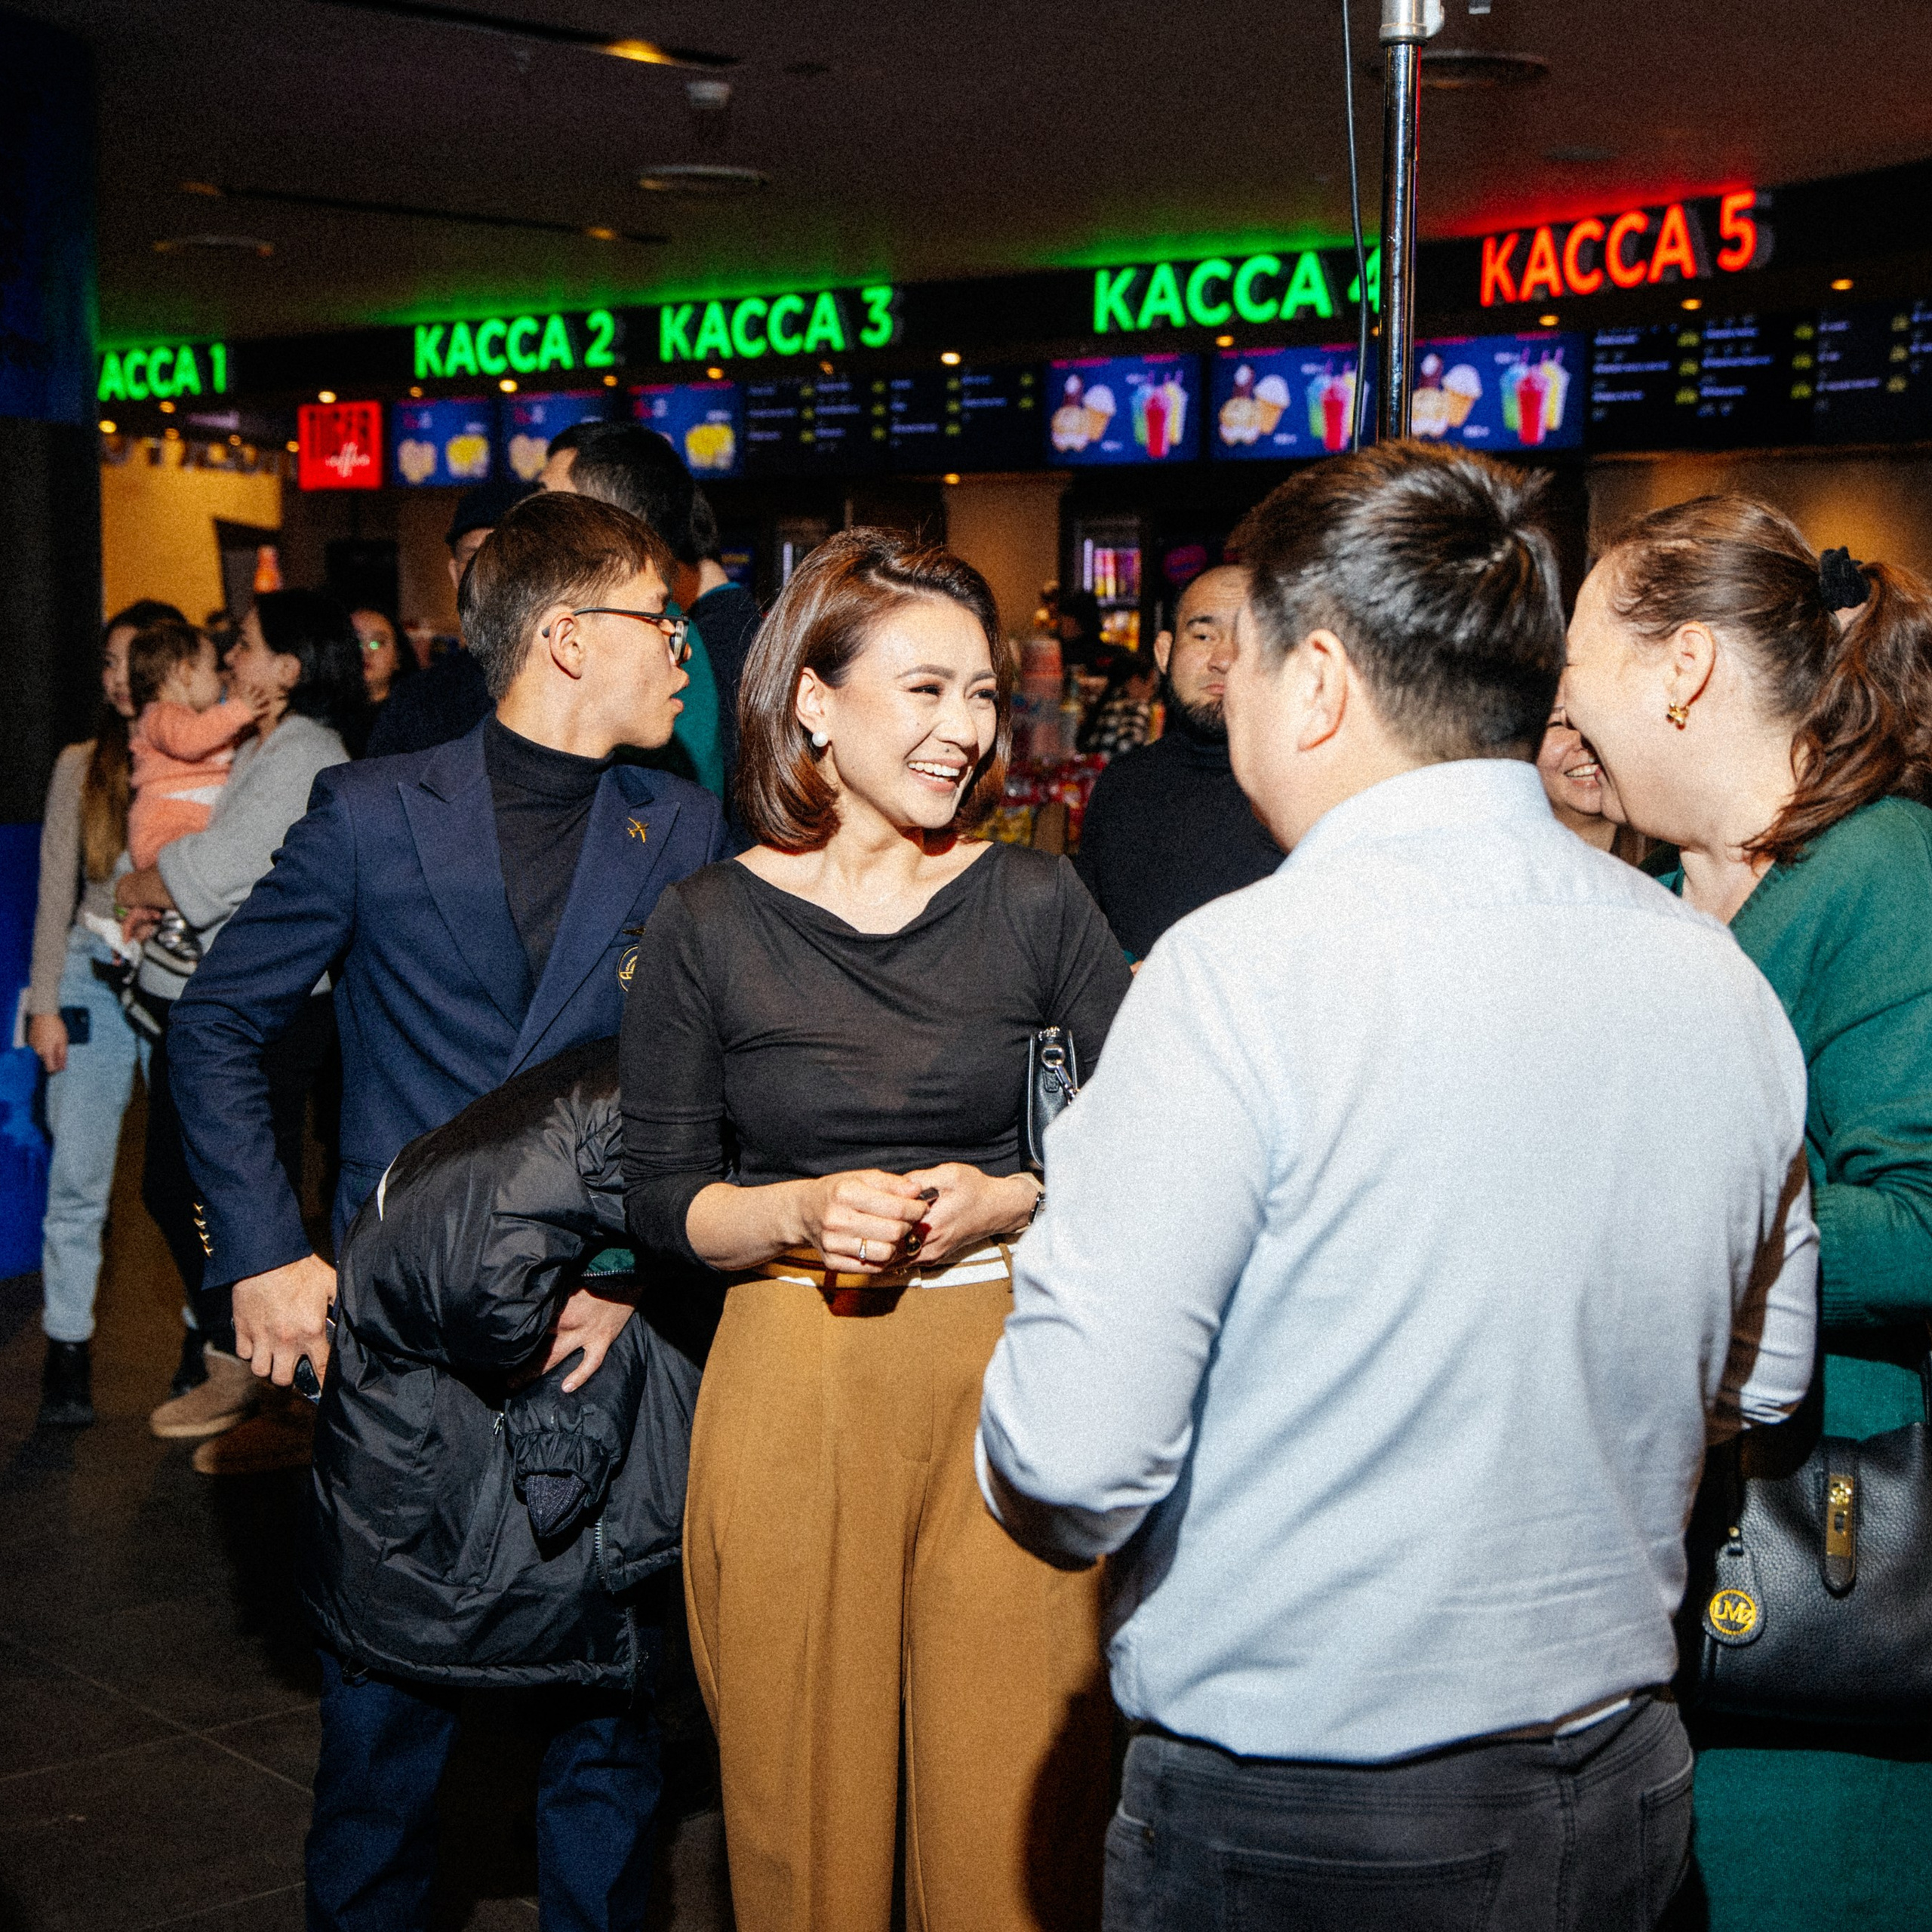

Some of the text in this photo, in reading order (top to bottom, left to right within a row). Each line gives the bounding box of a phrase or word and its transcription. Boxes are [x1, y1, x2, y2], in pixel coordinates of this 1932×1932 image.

[1479, 189, 1758, 307] КАССА 5
[660, 285, 894, 362] КАССА 3
[1093, 245, 1381, 334] КАССА 4
[97, 342, 226, 402] АССА 1
[414, 309, 615, 379] КАССА 2
